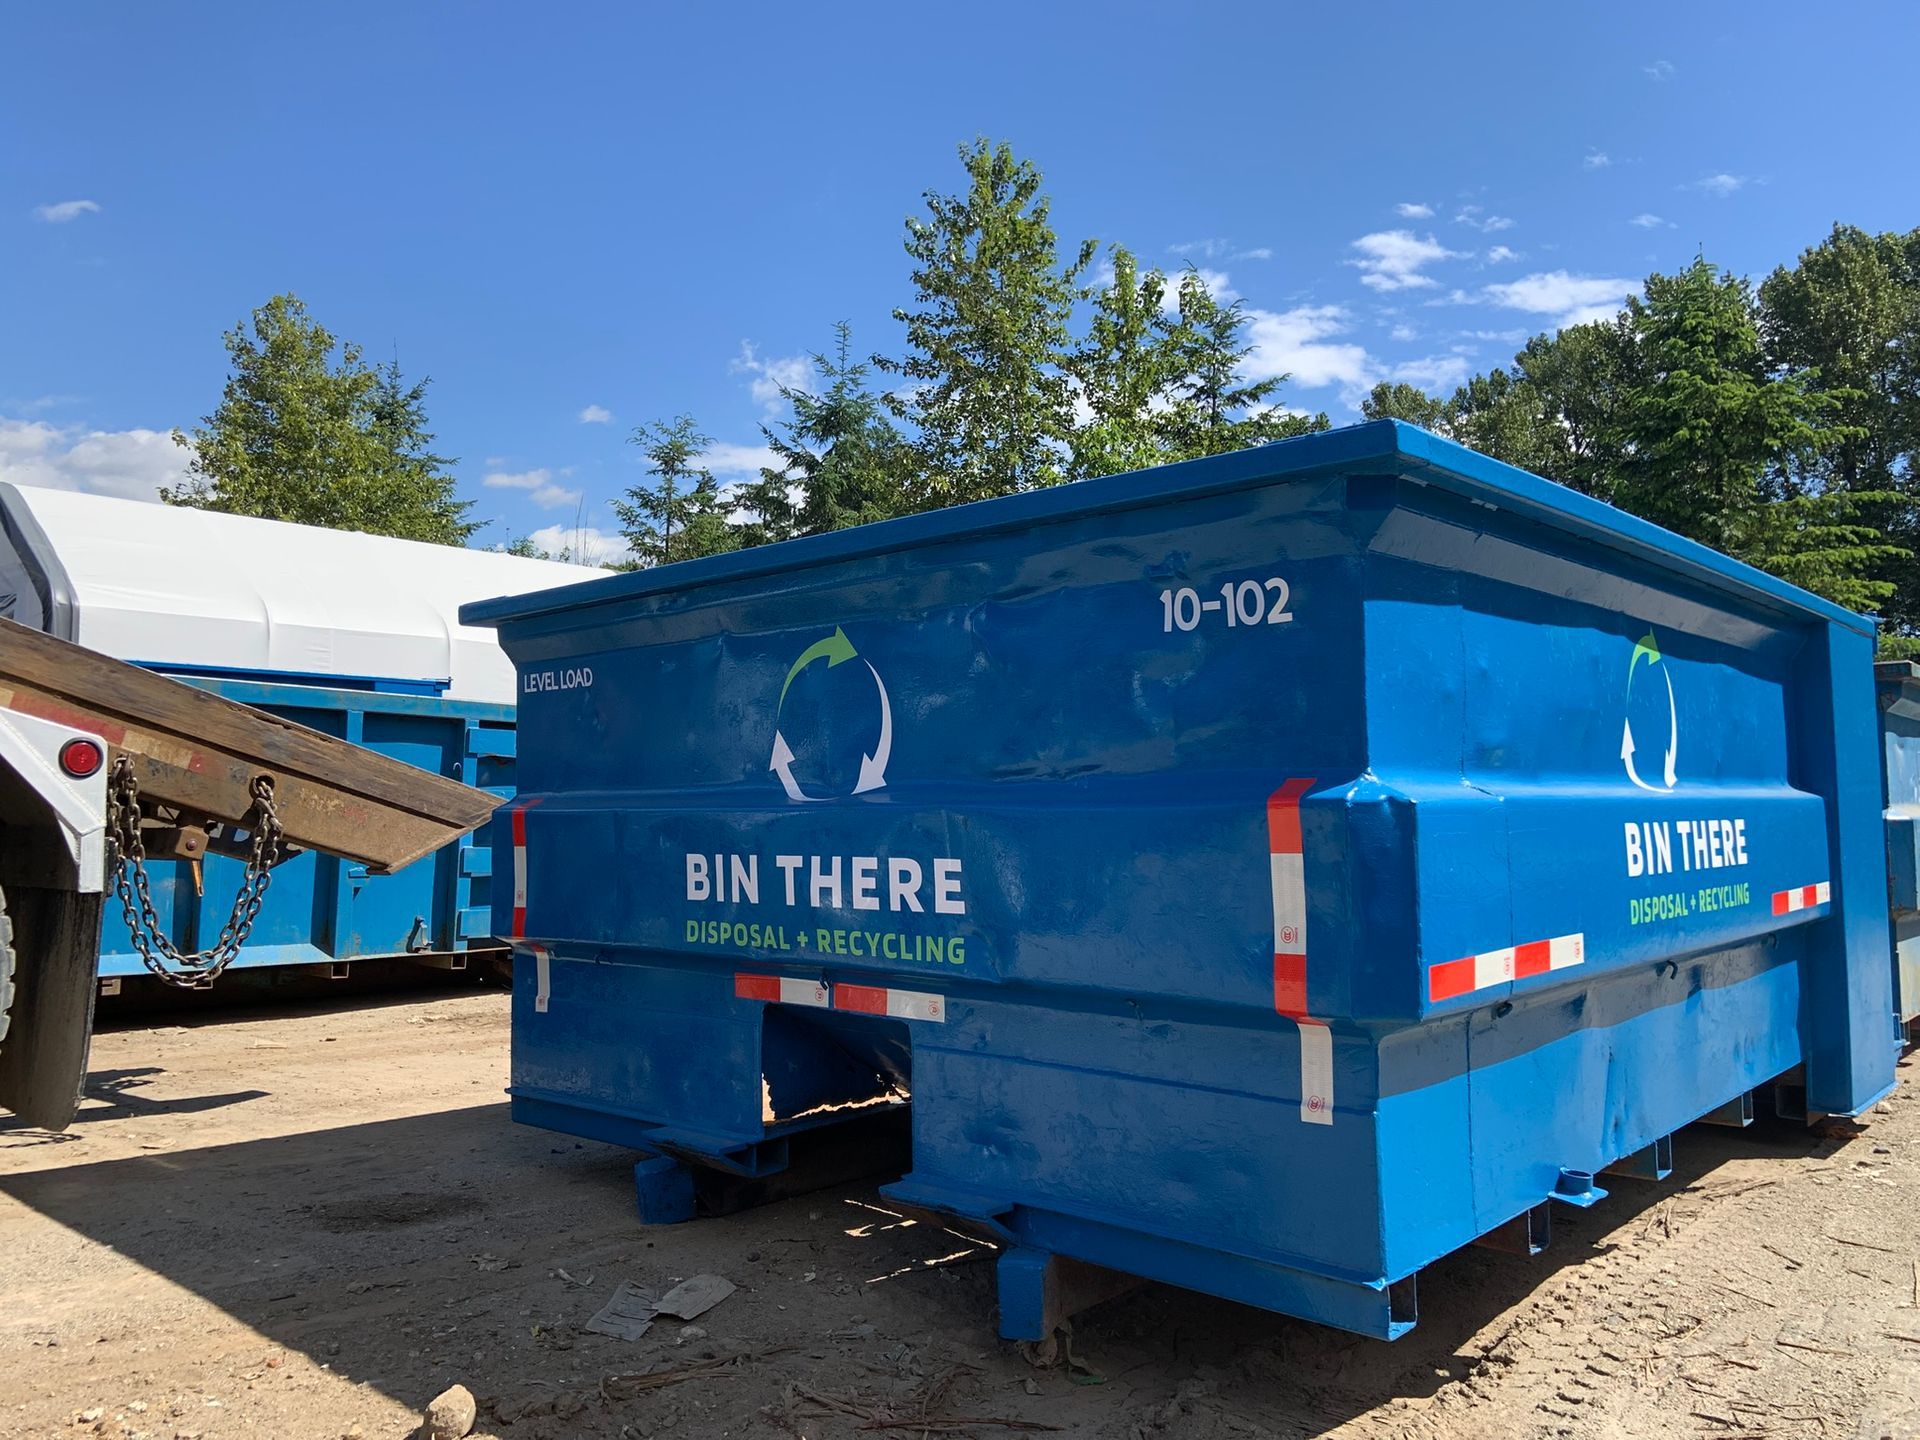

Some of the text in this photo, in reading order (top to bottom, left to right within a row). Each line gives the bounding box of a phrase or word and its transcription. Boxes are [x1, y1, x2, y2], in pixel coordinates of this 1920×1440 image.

[1159, 577, 1293, 633] 10-102
[524, 667, 593, 694] LEVEL LOAD
[1624, 818, 1748, 878] BIN THERE
[685, 853, 966, 915] BIN THERE
[1630, 893, 1688, 926] DISPOSAL
[1699, 882, 1750, 914] RECYCLING
[686, 919, 790, 951] DISPOSAL
[817, 928, 966, 965] RECYCLING
